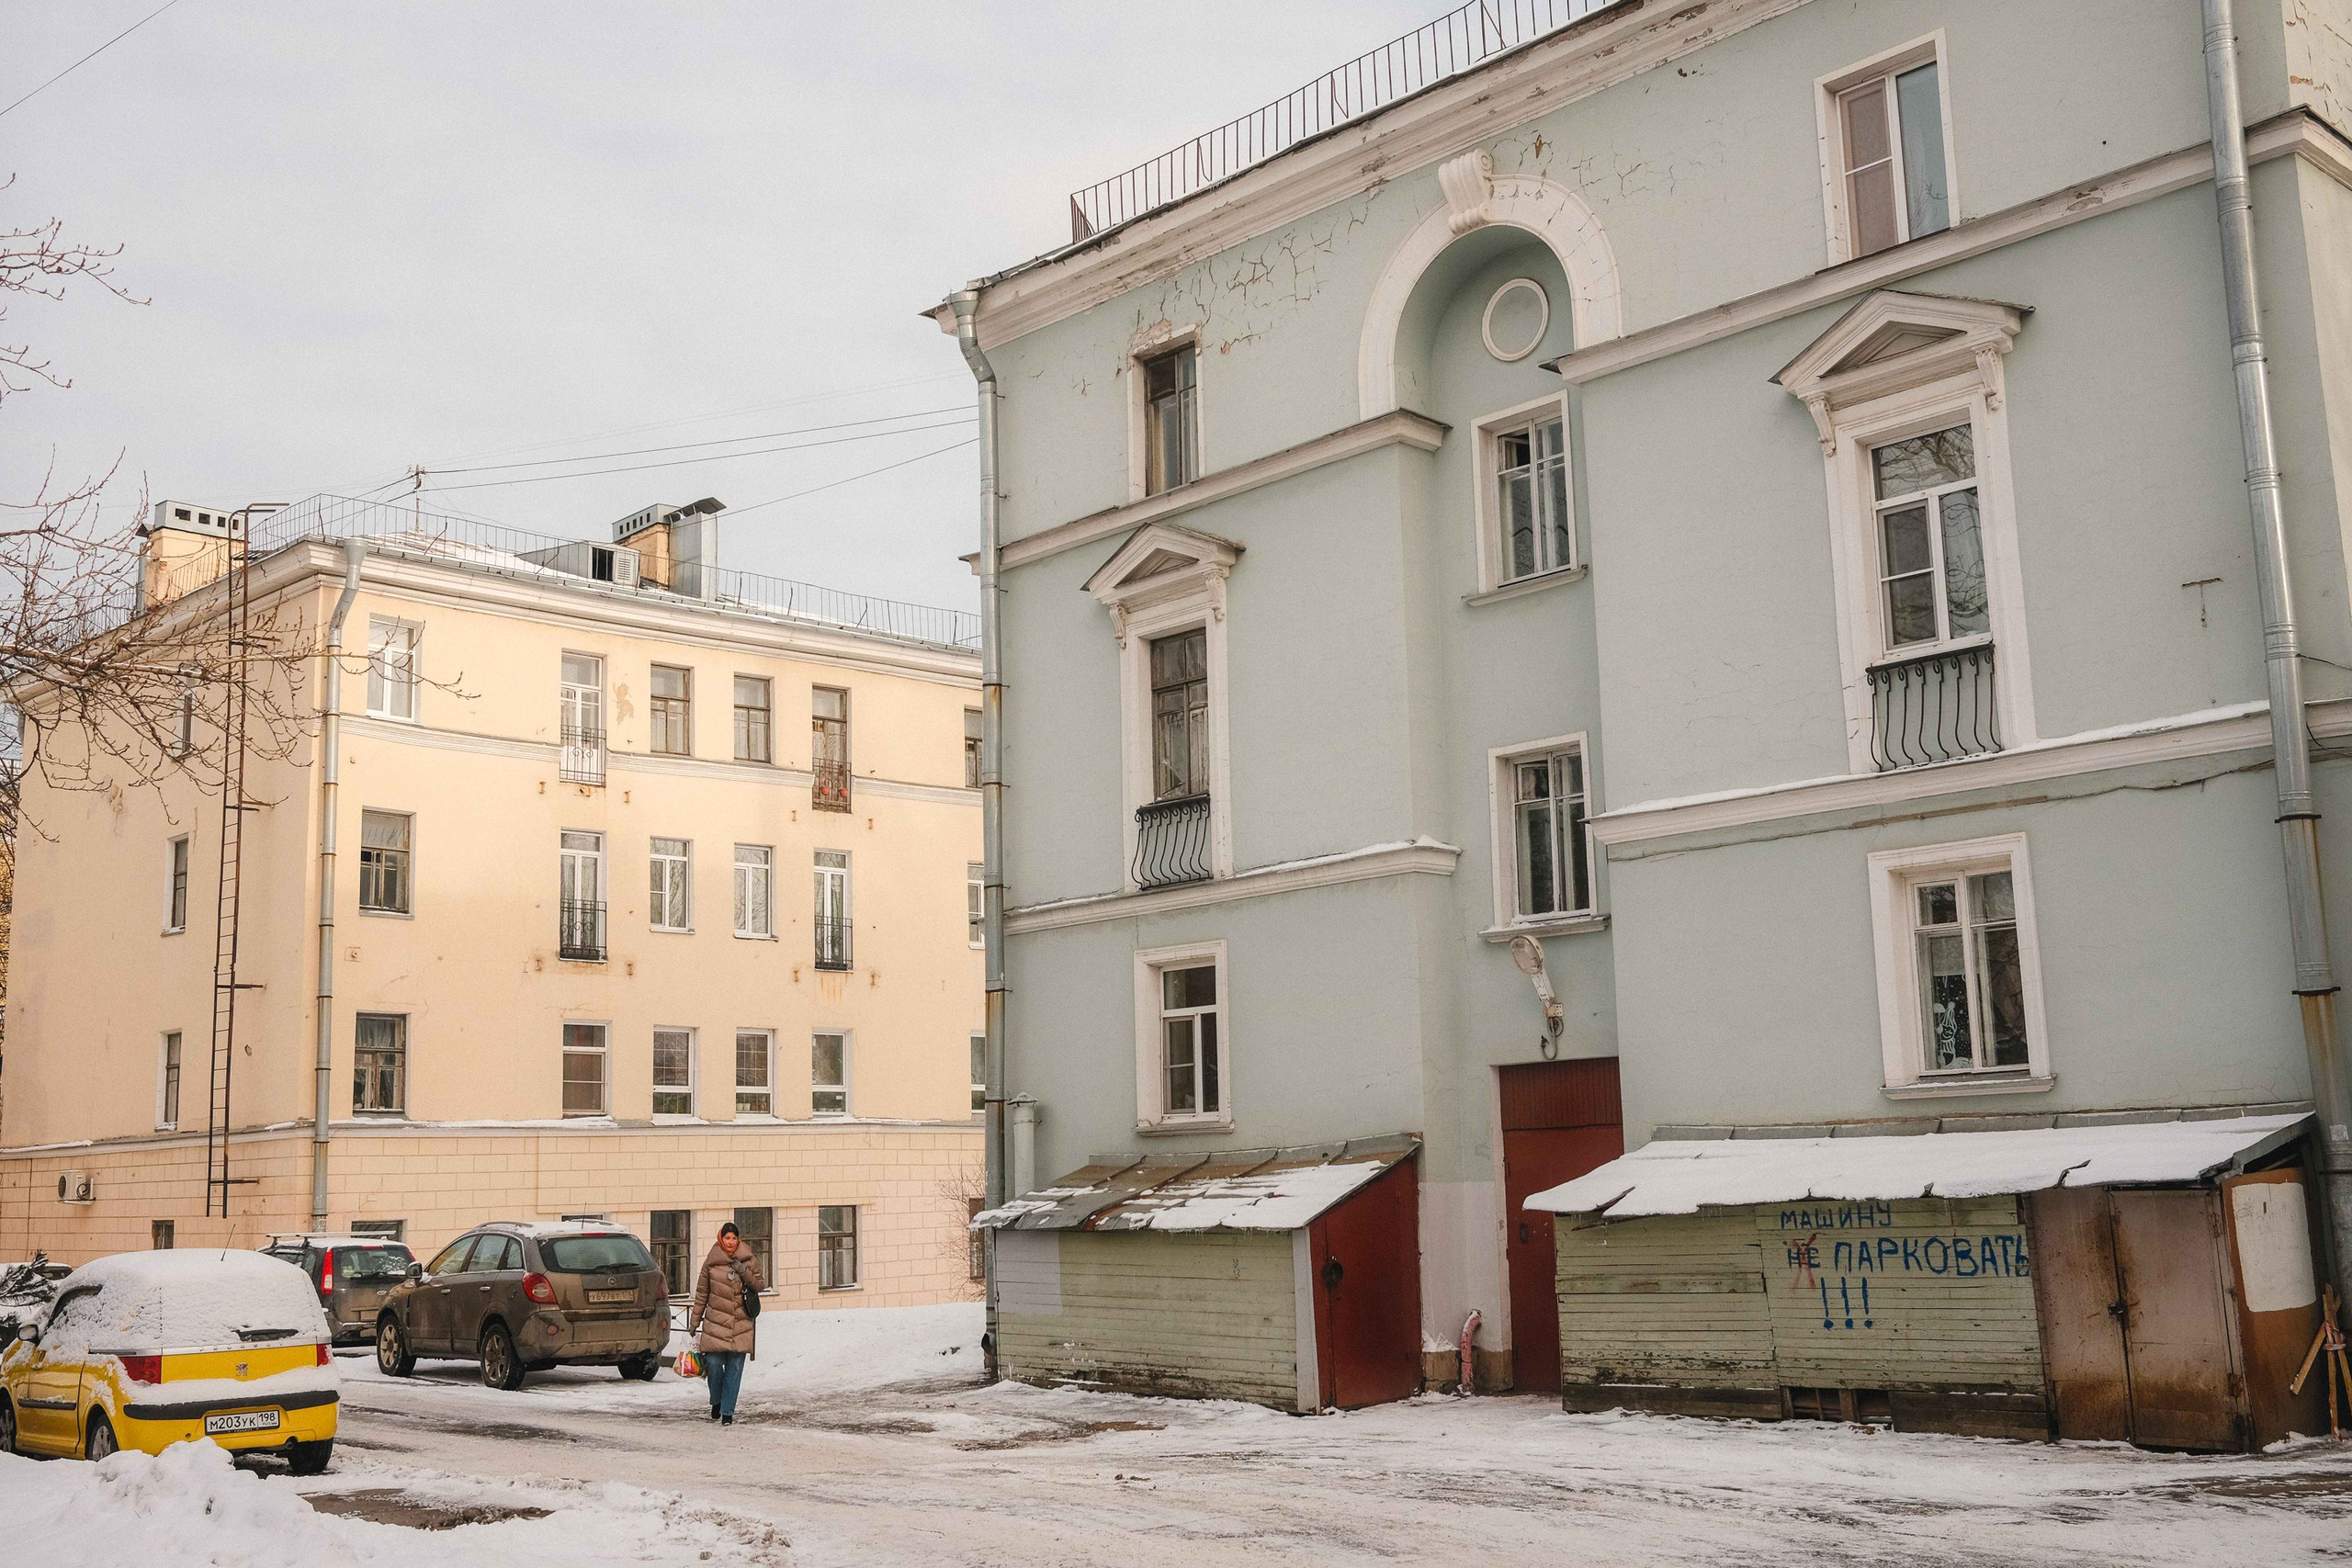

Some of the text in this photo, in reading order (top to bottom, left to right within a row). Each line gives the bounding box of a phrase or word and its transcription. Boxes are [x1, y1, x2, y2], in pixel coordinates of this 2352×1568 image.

[1781, 1201, 1893, 1229] МАШИНУ
[1834, 1235, 2030, 1278] ПАРКОВАТЬ
[210, 1412, 276, 1430] М203УК 198
